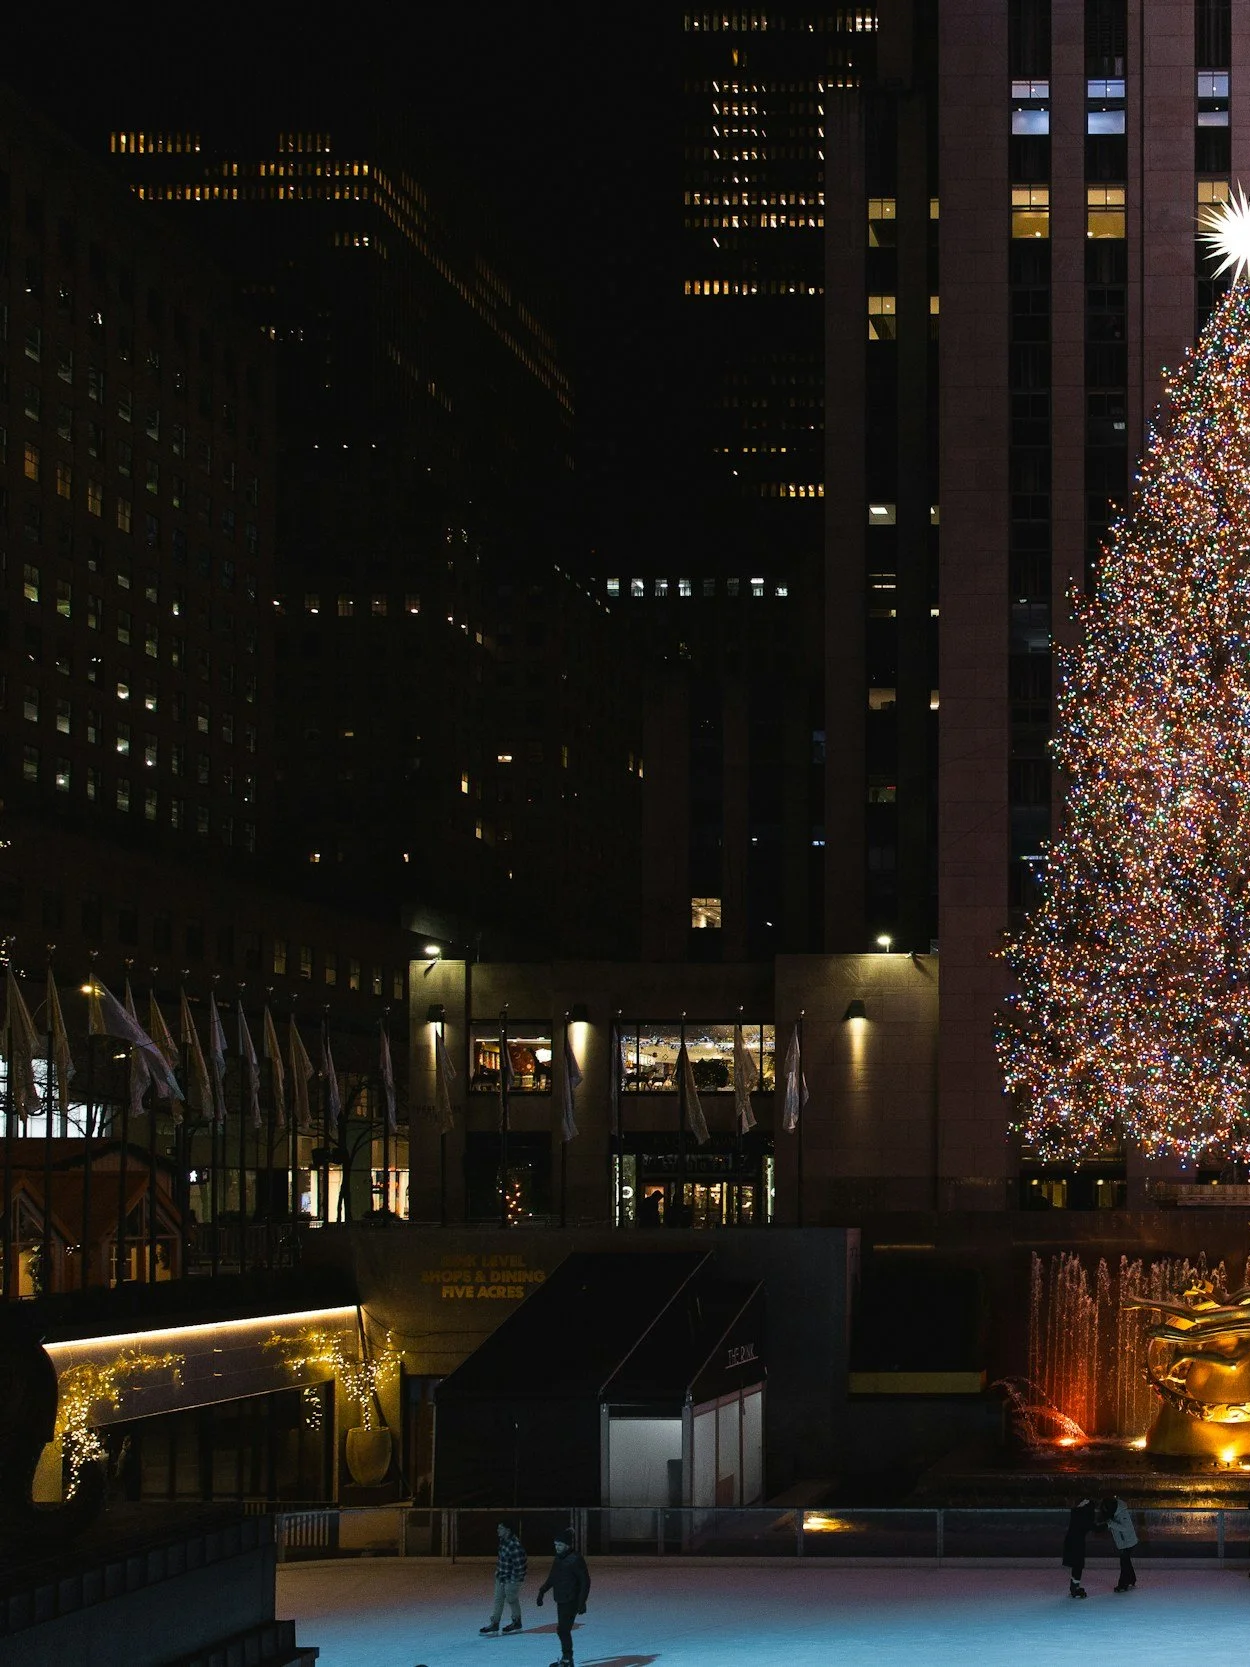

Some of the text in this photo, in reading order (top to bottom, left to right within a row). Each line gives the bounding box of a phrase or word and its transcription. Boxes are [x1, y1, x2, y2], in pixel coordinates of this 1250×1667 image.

[420, 1270, 546, 1284] SHOPS & DINING
[441, 1285, 525, 1299] FIVE ACRES
[727, 1347, 739, 1365] THE
